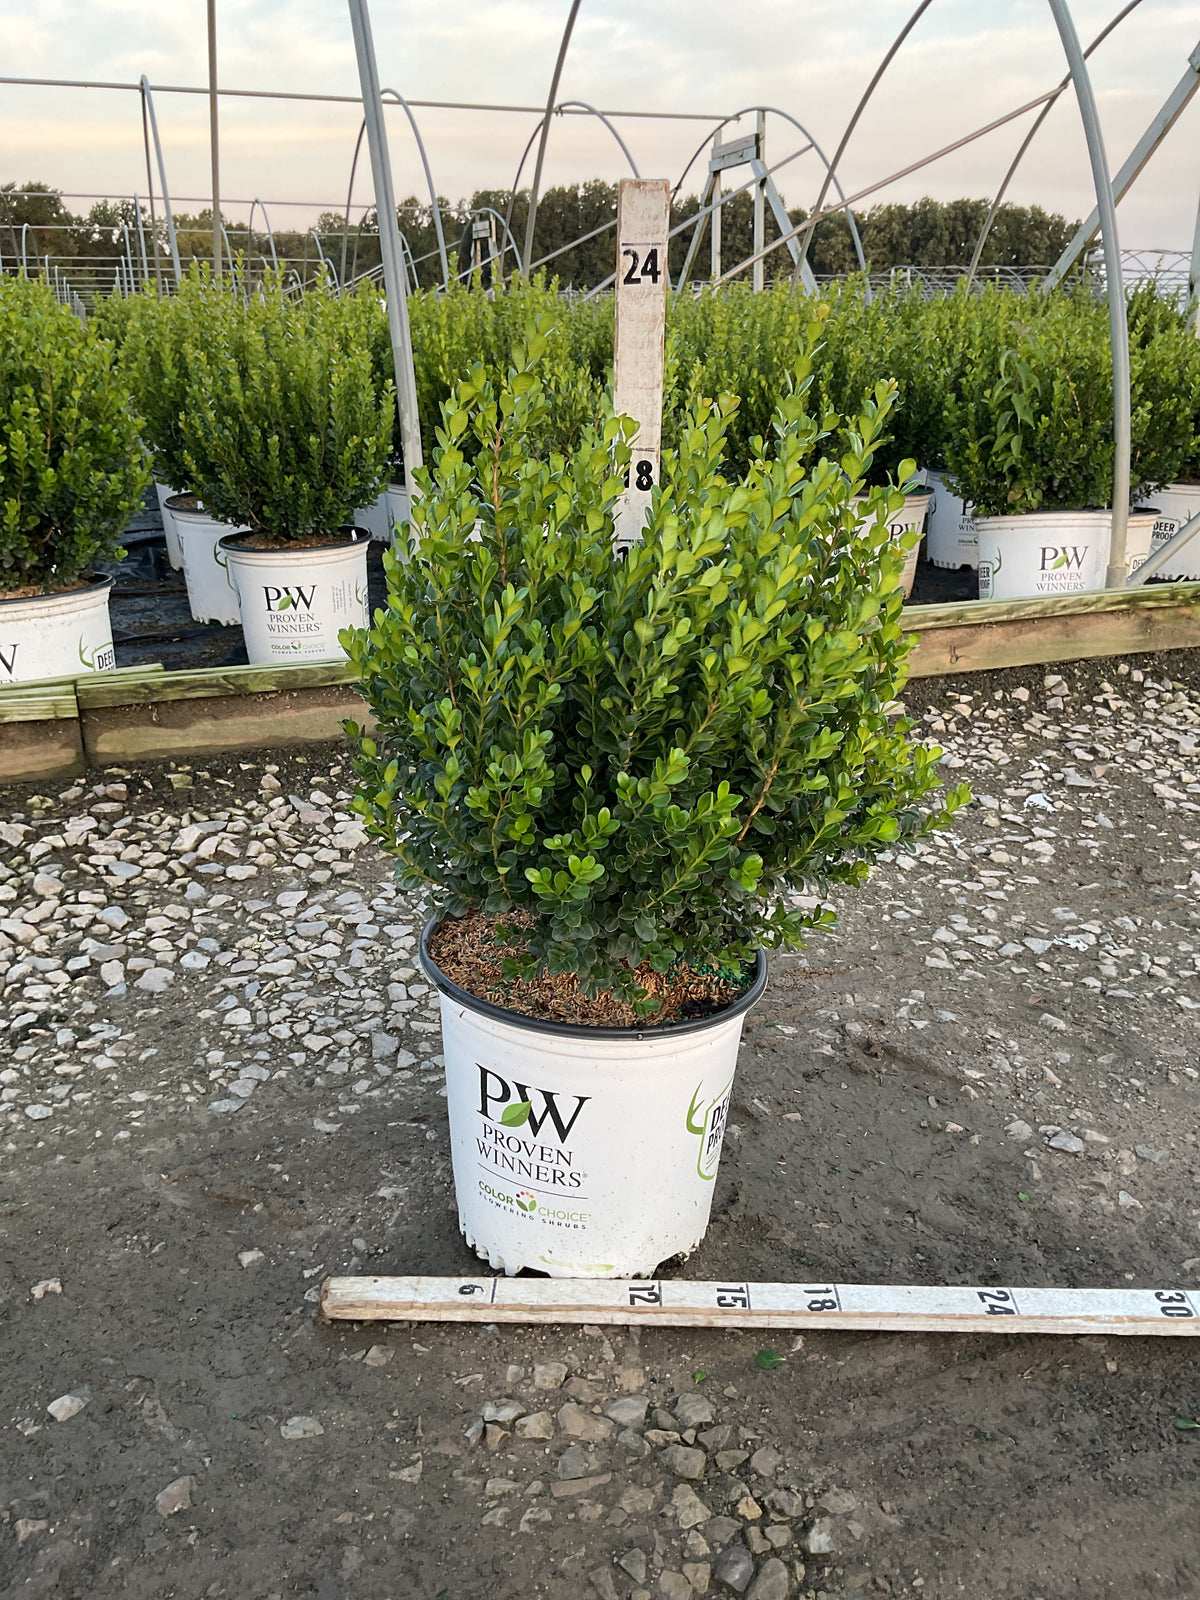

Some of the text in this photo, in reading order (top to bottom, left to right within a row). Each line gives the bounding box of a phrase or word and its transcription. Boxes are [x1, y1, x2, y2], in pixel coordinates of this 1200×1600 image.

[622, 248, 662, 286] 24
[1153, 521, 1176, 533] DEER
[1038, 545, 1089, 572] PW
[1036, 582, 1085, 592] WINNERS
[1041, 572, 1083, 582] PROVEN
[262, 584, 318, 612] PW
[266, 622, 321, 634] WINNERS
[269, 613, 316, 623] PROVEN
[475, 1062, 593, 1144] PW
[482, 1122, 575, 1167] PROVEN
[475, 1136, 583, 1188] WINNERS
[478, 1180, 589, 1223] COLOR CHOICE
[479, 1190, 587, 1230] FLOWERING SHRUBS
[628, 1284, 661, 1306] 12
[716, 1286, 747, 1308] 15
[803, 1287, 837, 1312] 18
[976, 1289, 1016, 1316] 24
[1154, 1290, 1194, 1318] 30
